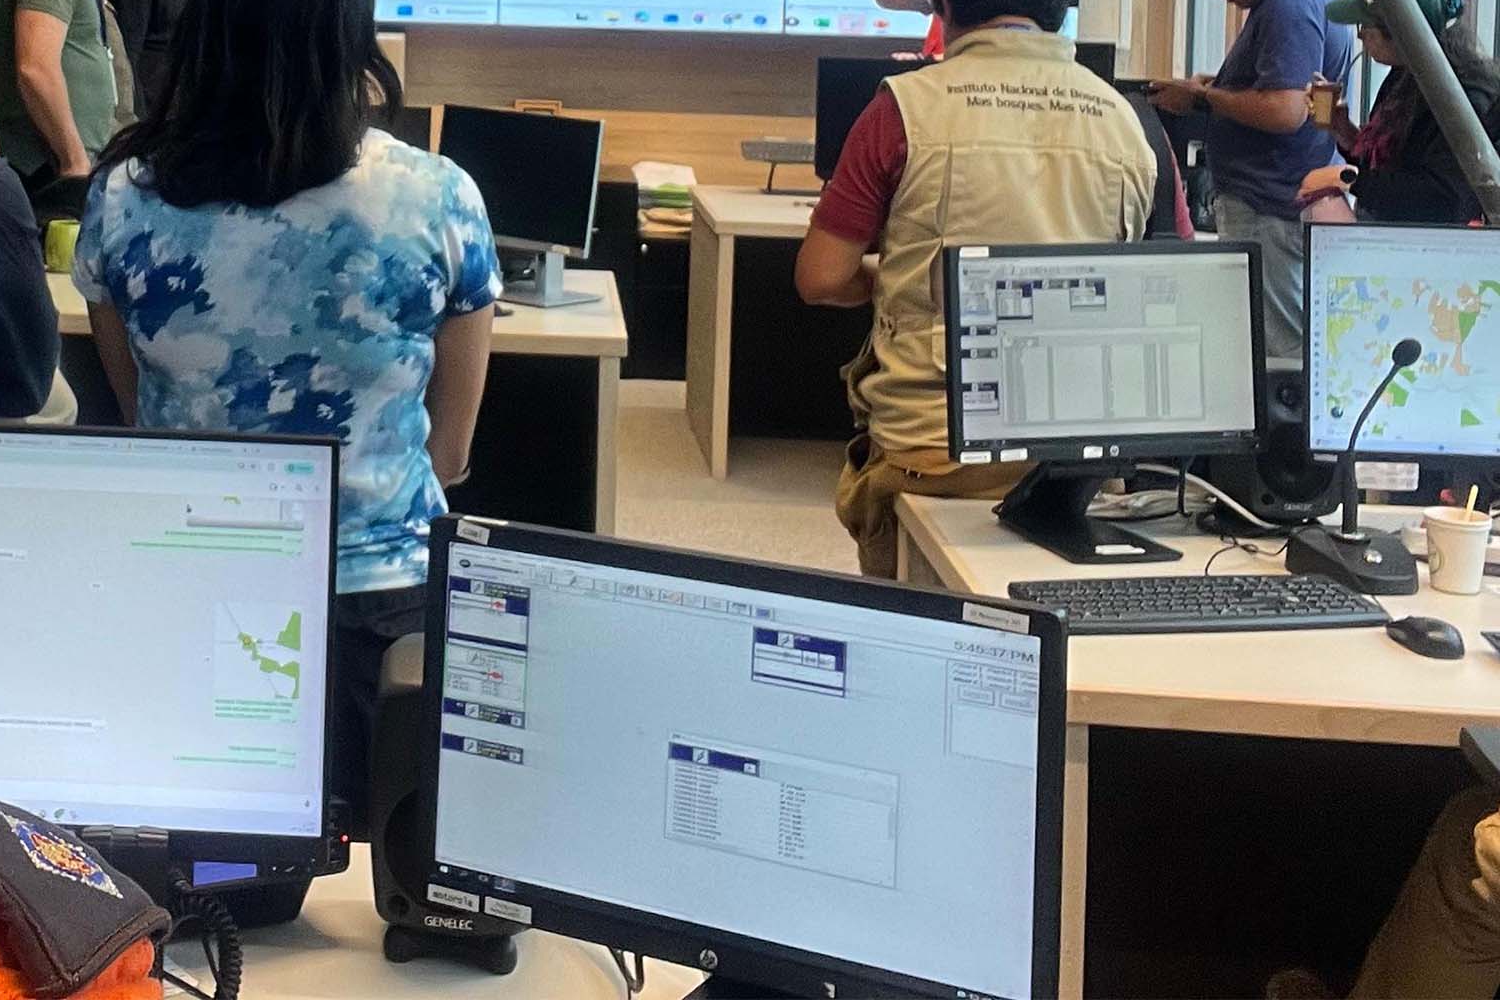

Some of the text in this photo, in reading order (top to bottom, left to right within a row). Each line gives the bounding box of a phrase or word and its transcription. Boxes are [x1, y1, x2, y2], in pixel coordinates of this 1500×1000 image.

[946, 82, 997, 95] Instituto
[1000, 83, 1048, 97] Nacional
[1052, 86, 1066, 97] de
[1010, 650, 1035, 663] PM
[423, 915, 473, 931] GENELEC
